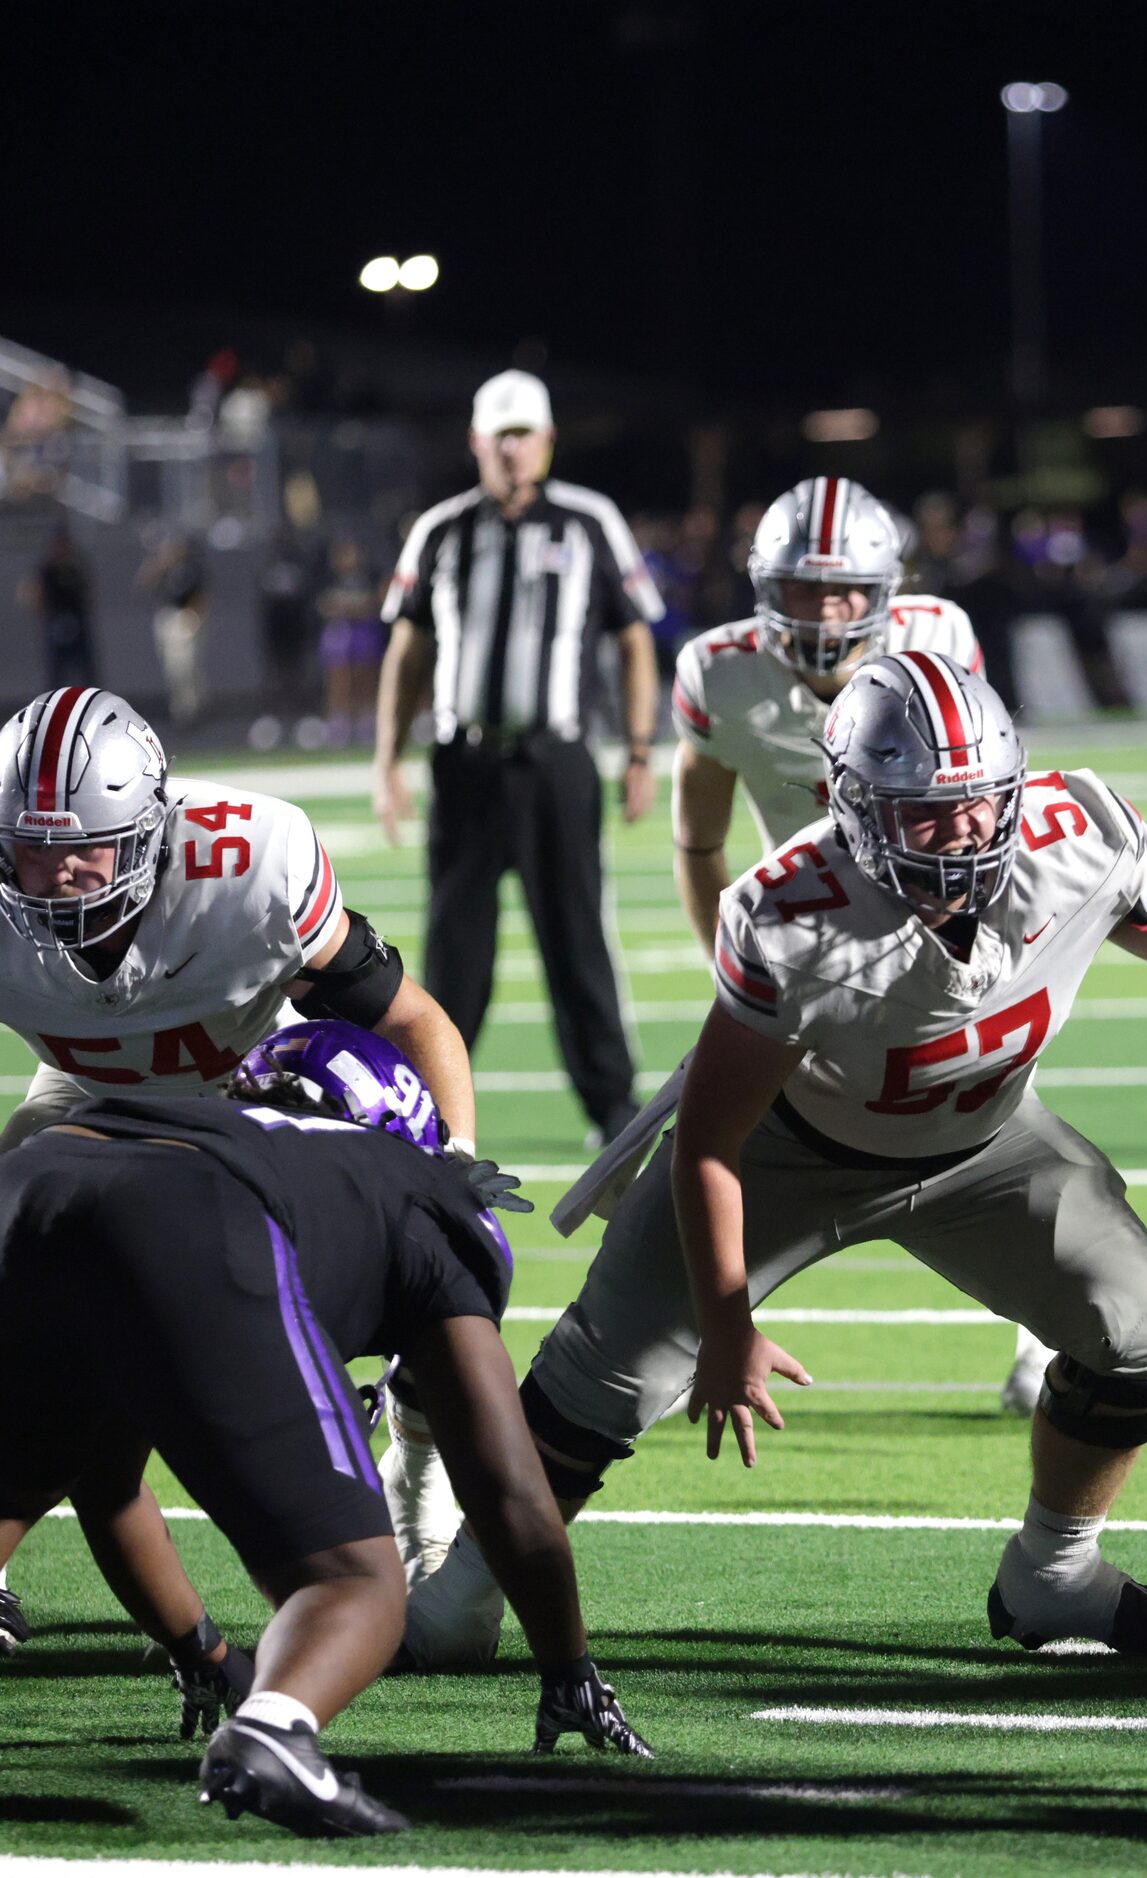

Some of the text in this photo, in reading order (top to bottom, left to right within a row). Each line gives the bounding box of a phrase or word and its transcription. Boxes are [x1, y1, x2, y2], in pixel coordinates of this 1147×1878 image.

[936, 769, 985, 785] Riddell
[24, 814, 72, 828] Riddell
[185, 800, 253, 881] 54
[755, 841, 851, 923] 57
[36, 1020, 246, 1085] 54
[865, 986, 1052, 1115] 57
[385, 1062, 436, 1142] 91
